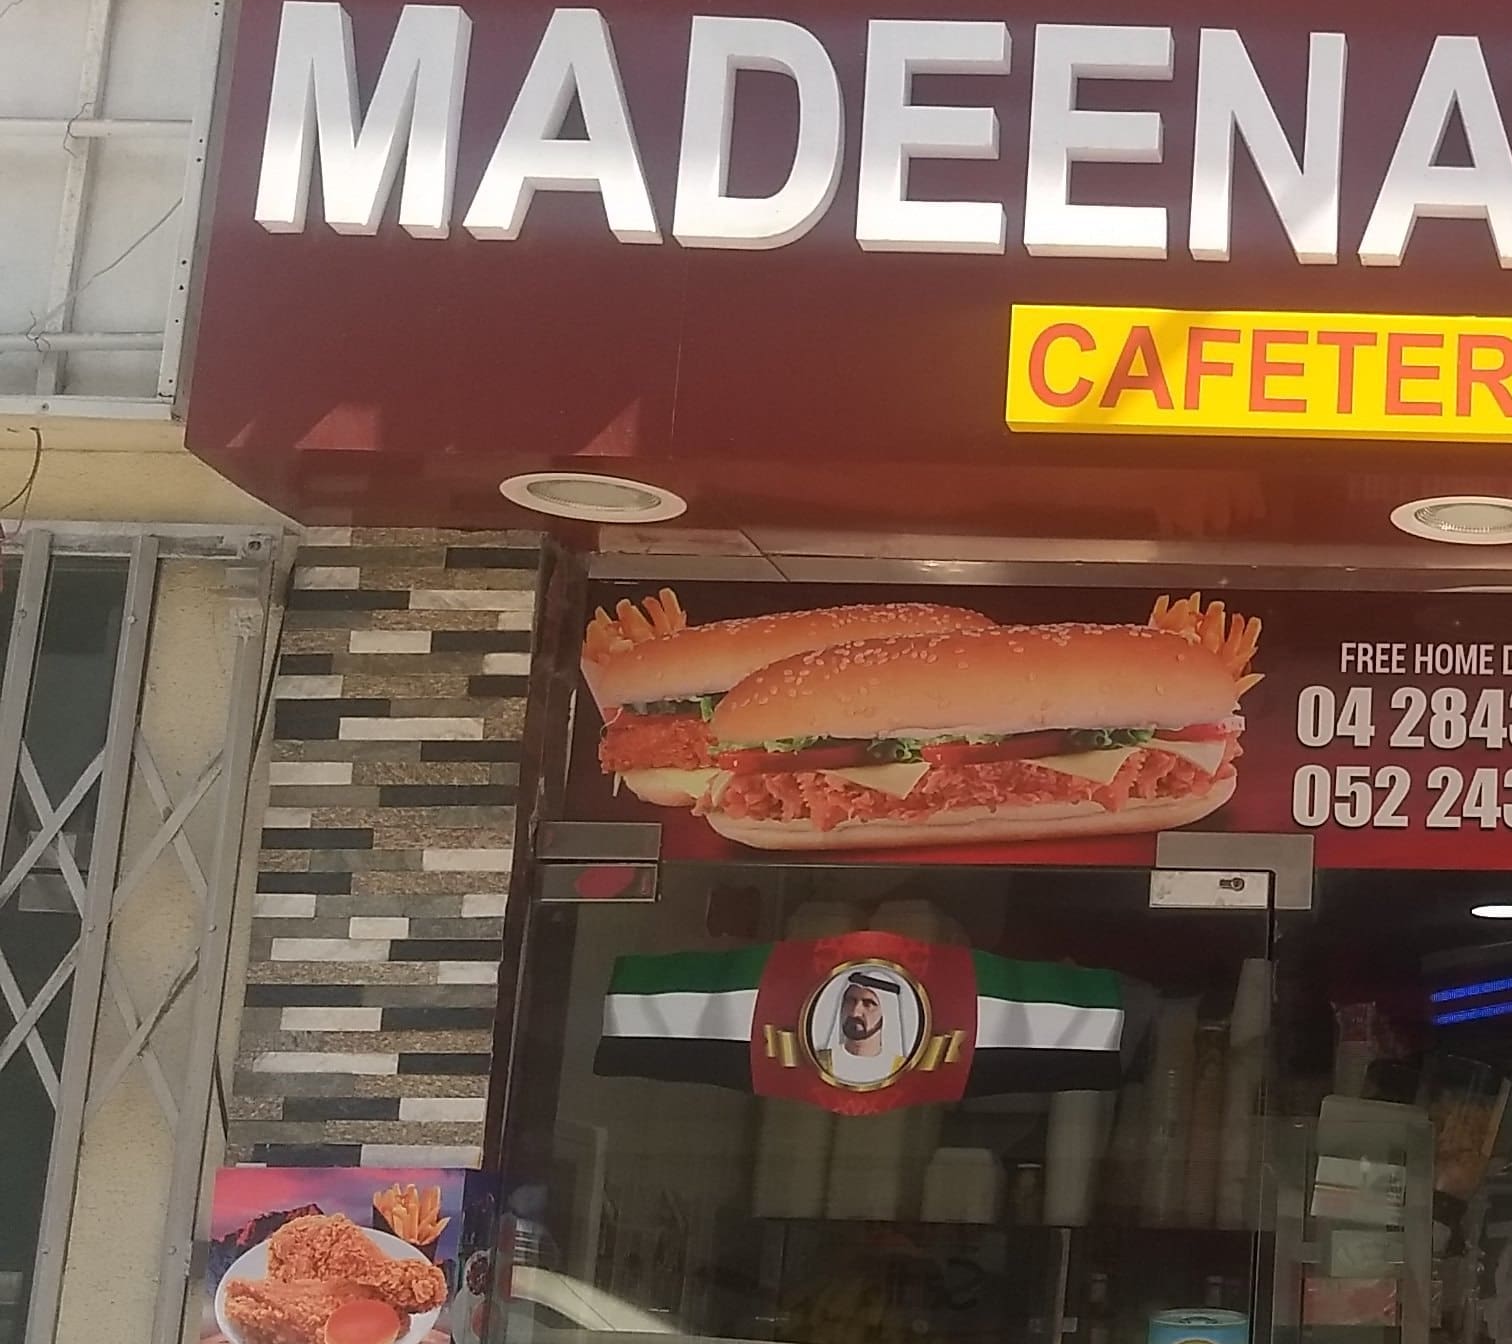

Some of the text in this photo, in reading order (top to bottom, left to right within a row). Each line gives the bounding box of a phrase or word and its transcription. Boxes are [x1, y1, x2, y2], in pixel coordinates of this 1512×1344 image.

[1340, 642, 1406, 674] FREE
[1414, 643, 1495, 676] HOME
[1296, 685, 1376, 748] 04
[1292, 764, 1412, 828] 052
